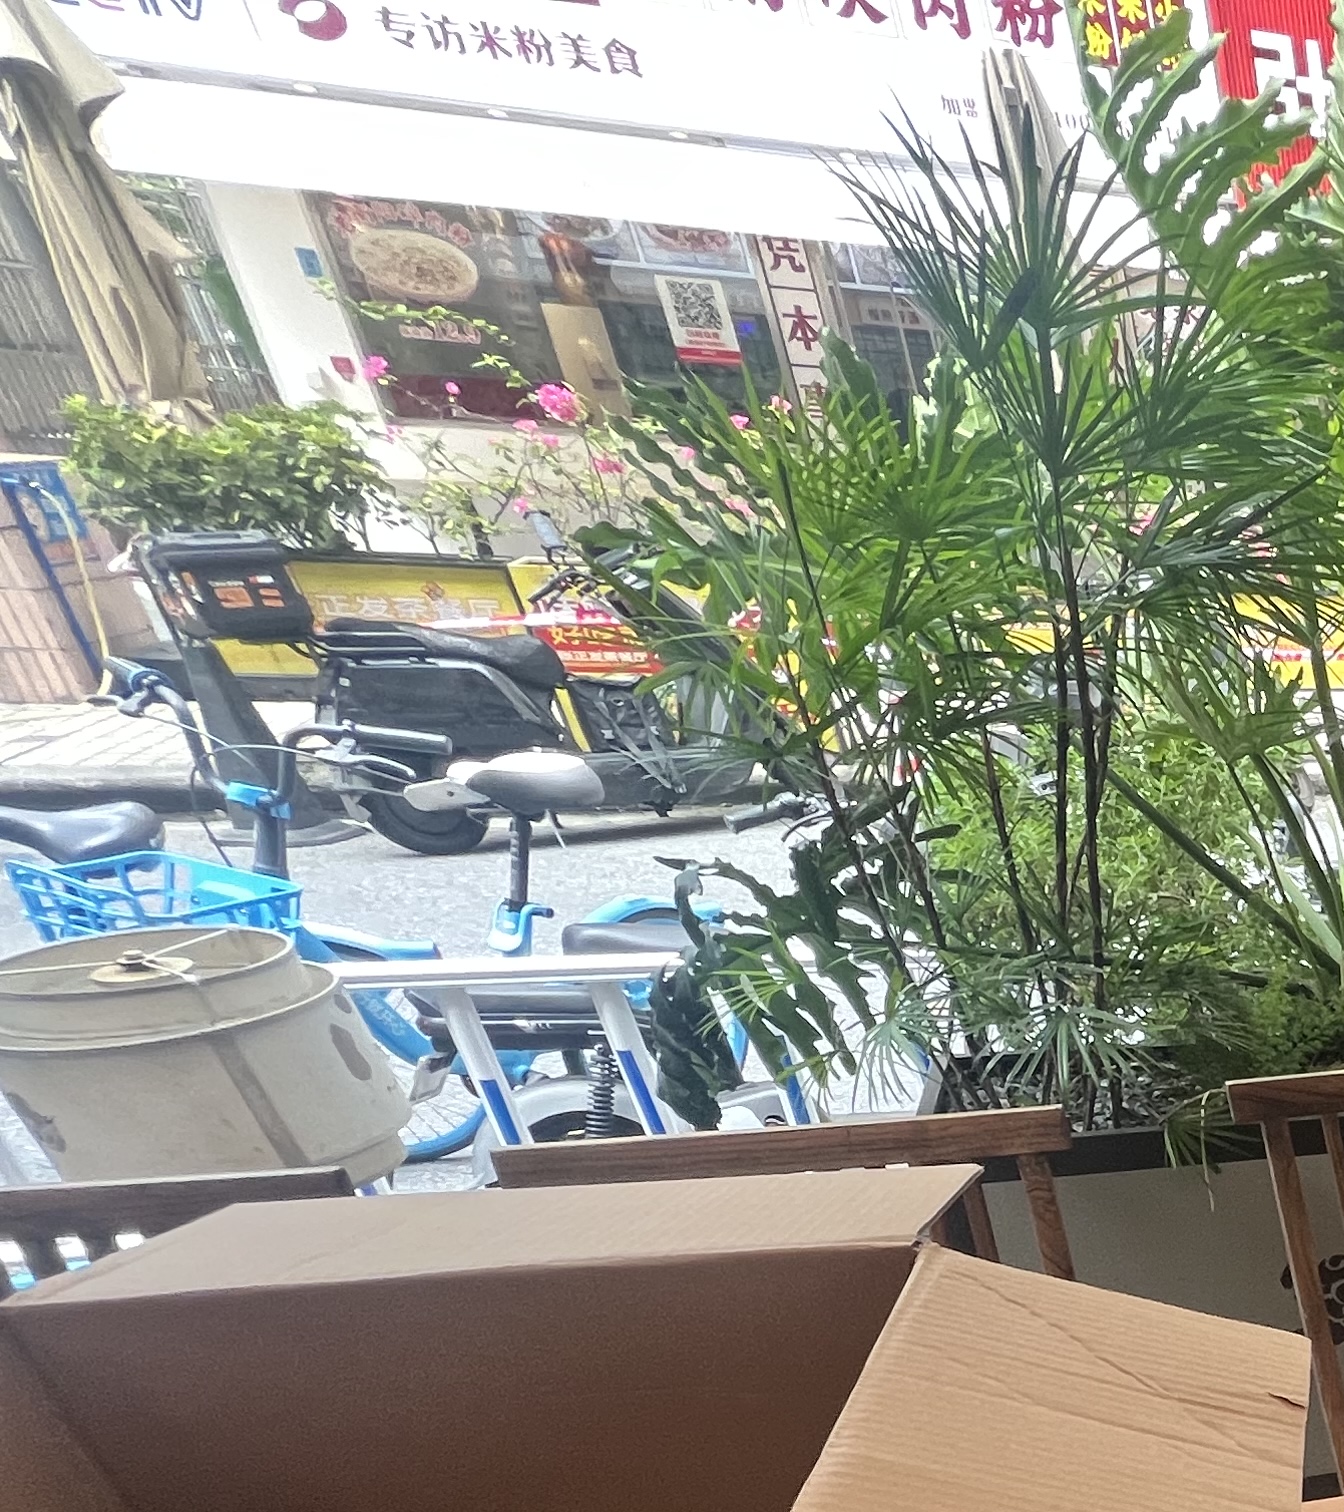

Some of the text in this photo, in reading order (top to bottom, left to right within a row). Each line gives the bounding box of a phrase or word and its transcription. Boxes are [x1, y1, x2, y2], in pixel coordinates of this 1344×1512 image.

[374, 5, 643, 77] 专访米粉美食
